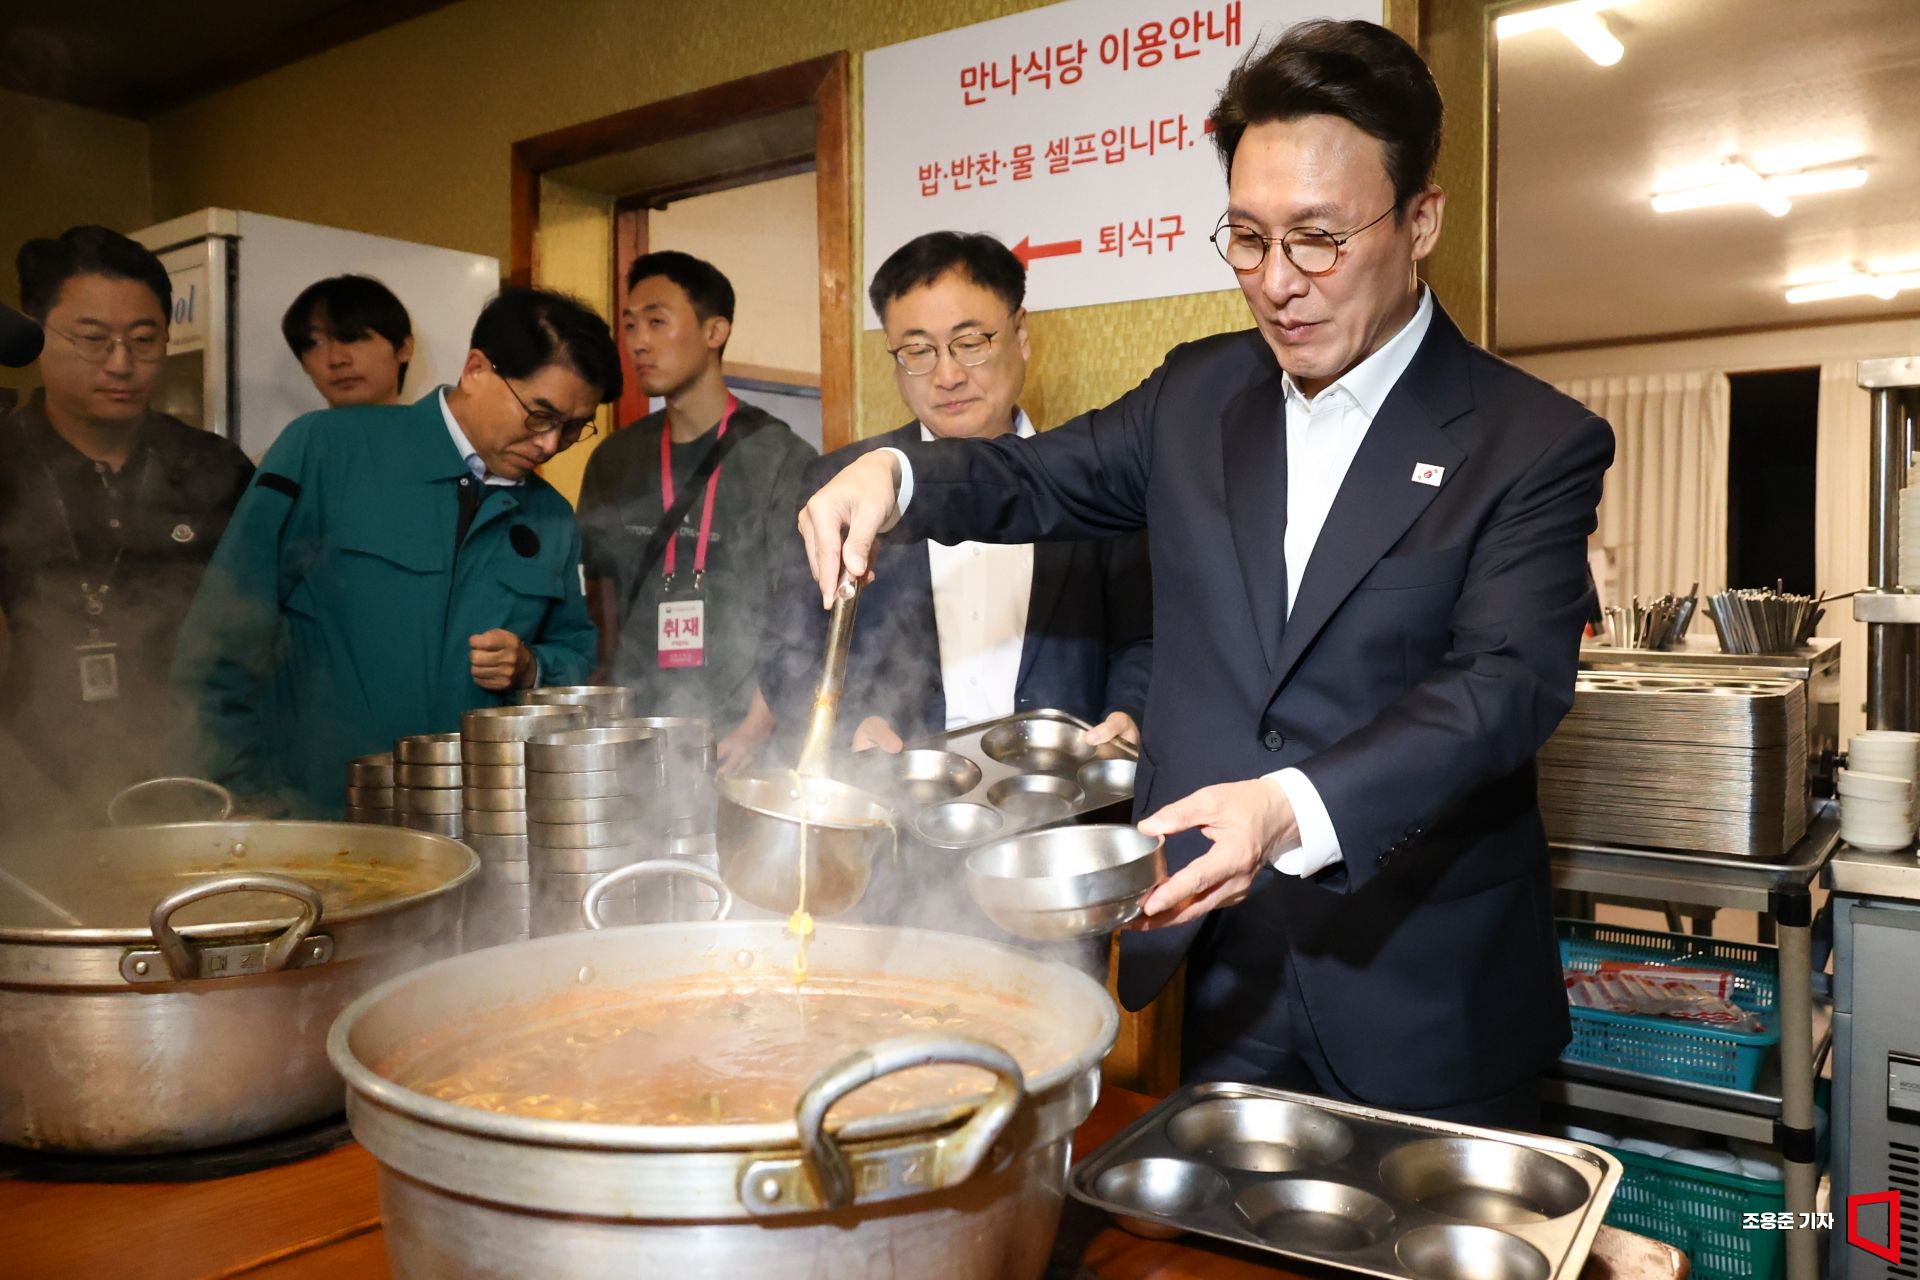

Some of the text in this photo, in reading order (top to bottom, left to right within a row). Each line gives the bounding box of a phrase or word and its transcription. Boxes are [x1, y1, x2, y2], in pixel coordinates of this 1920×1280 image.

[960, 0, 1242, 106] 만나식당 이용안내
[919, 114, 1194, 198] 밥·반찬·물 셀프입니다.
[1099, 215, 1184, 256] 퇴식구
[663, 616, 699, 638] 취재
